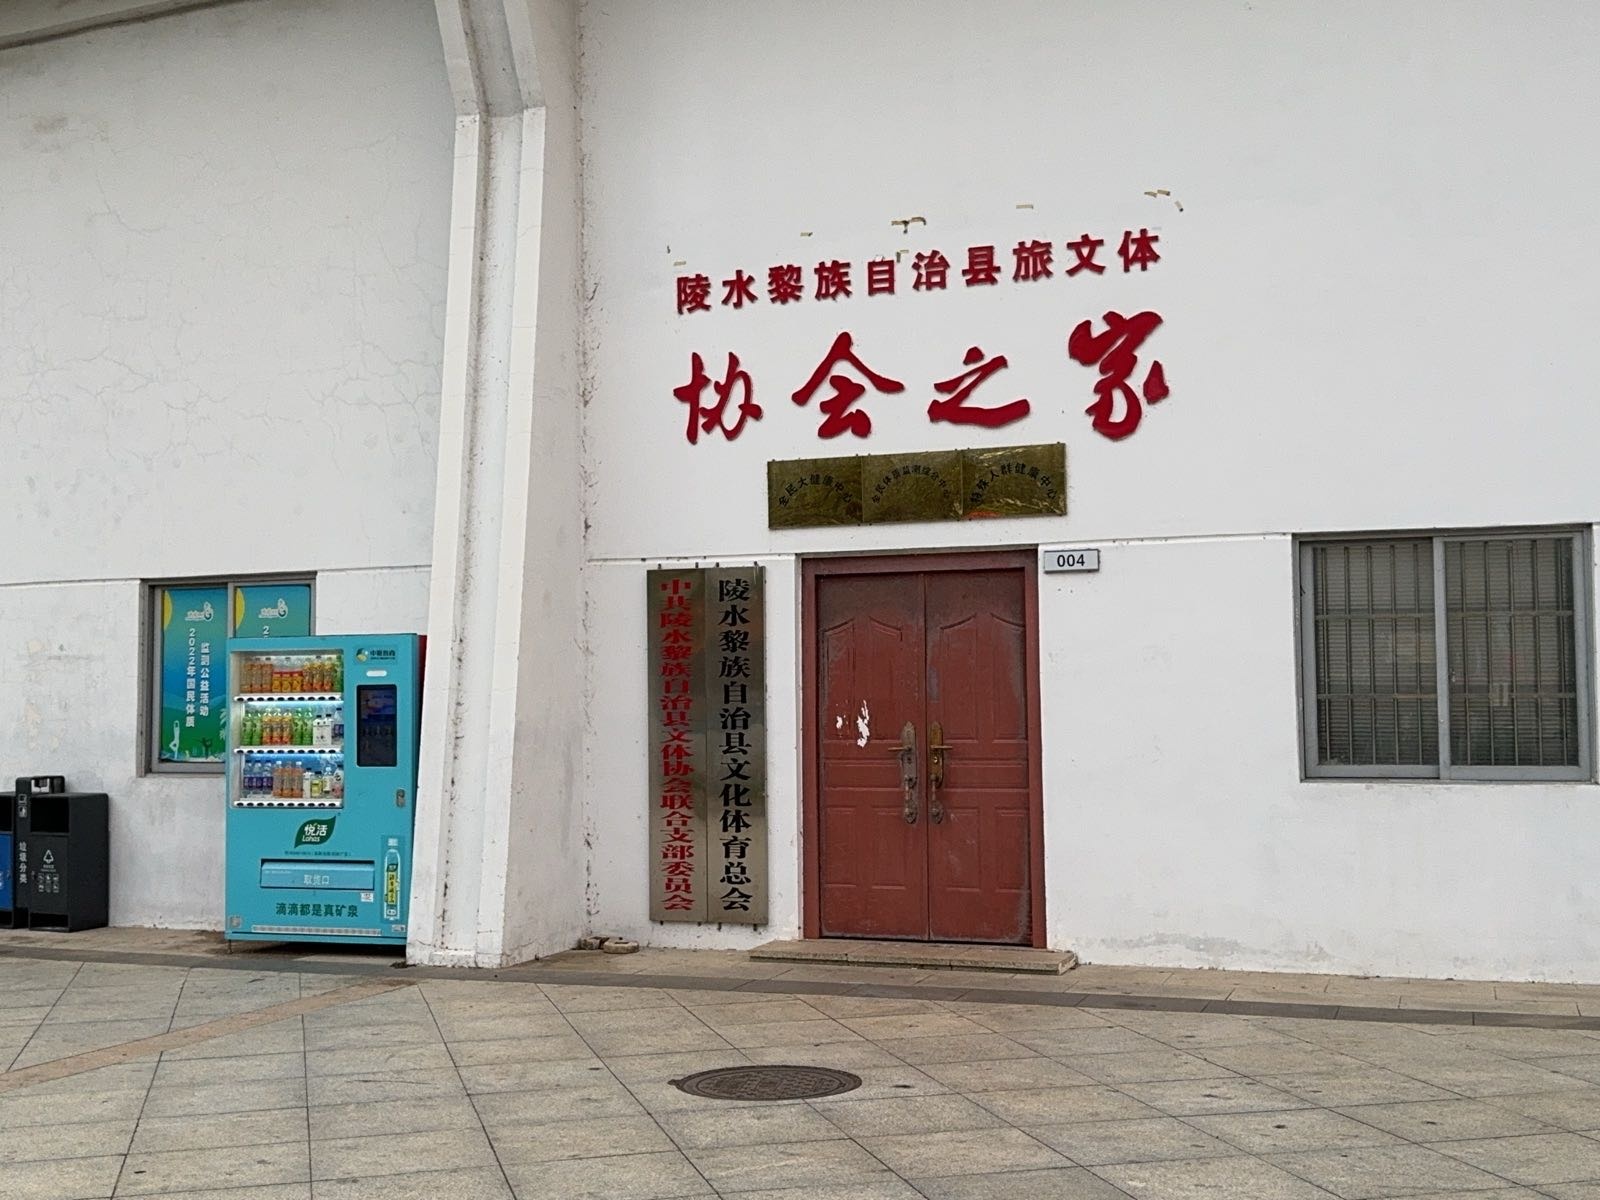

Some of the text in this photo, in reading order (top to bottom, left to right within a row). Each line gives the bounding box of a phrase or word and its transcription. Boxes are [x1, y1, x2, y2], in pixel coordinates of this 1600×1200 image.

[675, 228, 1161, 315] 陵水黎族自治县旅文体
[673, 310, 1169, 444] 协会之家
[969, 462, 1059, 505] 特殊人群健康中心
[1056, 554, 1085, 567] 004
[185, 627, 197, 728] 2022年国民体质
[199, 642, 211, 717] 监测公益活动
[718, 578, 753, 912] 陵水黎族自治县文化体育总会
[304, 823, 328, 837] 悦活
[18, 841, 28, 884] 垃圾分类
[303, 873, 331, 886] 取货口
[275, 902, 359, 919] 滴滴都是真矿泉
